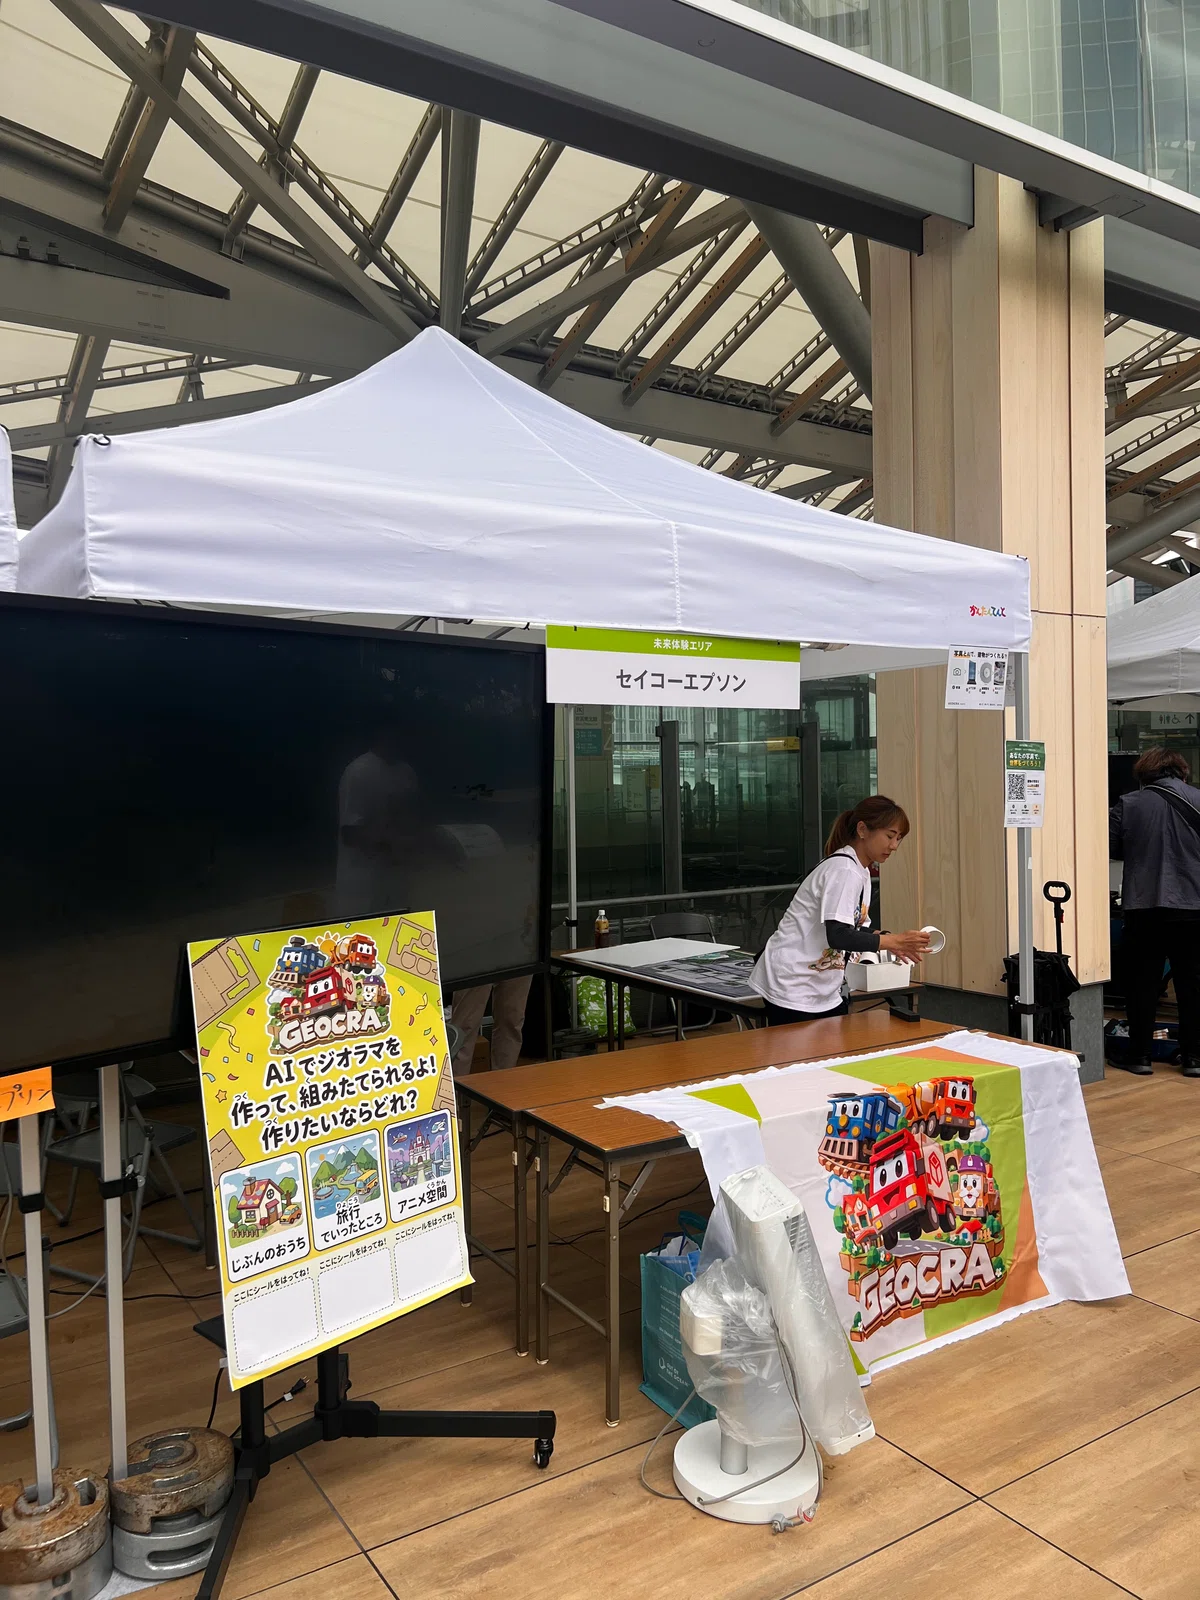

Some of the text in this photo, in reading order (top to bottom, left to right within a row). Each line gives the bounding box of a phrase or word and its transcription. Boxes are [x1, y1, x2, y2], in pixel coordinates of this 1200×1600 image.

[969, 604, 1006, 617] かんたんてんと
[653, 638, 713, 651] 未来体験エリア
[616, 669, 747, 693] セイコーエプソン
[279, 1010, 382, 1046] GEOCRA
[265, 1038, 401, 1087] AIでジオラマを
[262, 1090, 417, 1151] 作りたいならどれ?
[336, 1204, 361, 1225] 旅行
[397, 1185, 448, 1214] アニメ空間
[320, 1212, 383, 1243] でいったところ
[395, 1211, 456, 1241] ここにシールをはってね!
[231, 1236, 306, 1273] じぶんのおうち
[319, 1237, 387, 1270] ここにシールをはってね!
[233, 1267, 310, 1303] ここにシールをはってね!
[859, 1241, 996, 1328] GEOCRA
